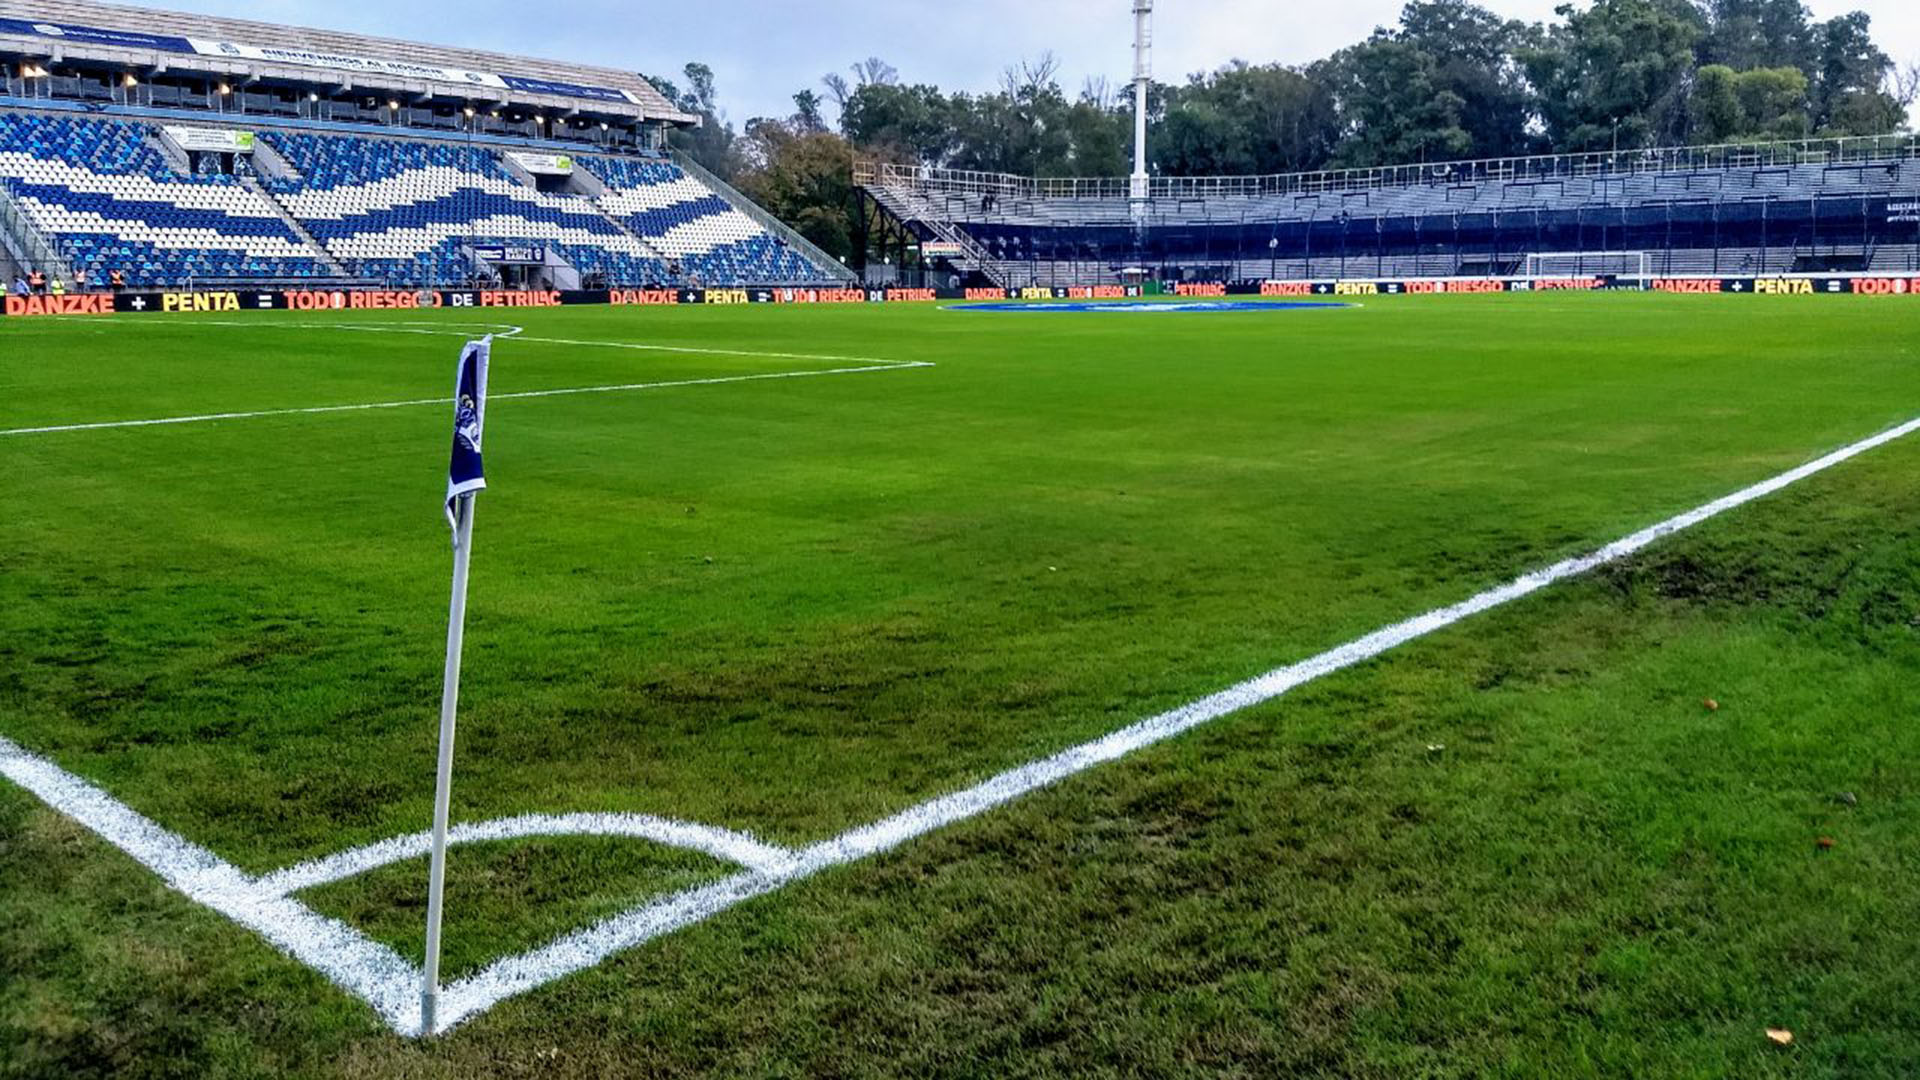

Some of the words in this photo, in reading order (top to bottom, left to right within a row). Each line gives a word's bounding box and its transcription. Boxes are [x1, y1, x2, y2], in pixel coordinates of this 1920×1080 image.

[260, 48, 362, 66] BIENVENIDOS
[964, 288, 1006, 300] DANZKE
[1021, 288, 1052, 300] PENTA
[1260, 282, 1312, 297] DANZKE
[1333, 282, 1377, 296] PENTA
[1402, 281, 1444, 294] TODO
[1446, 279, 1503, 294] RIESGO
[1510, 281, 1528, 292] DE
[1651, 279, 1721, 294] DANZKE
[1753, 279, 1814, 294] PENTA
[1849, 279, 1907, 294] TODO
[5, 293, 115, 315] DANZKE
[162, 292, 240, 312] PENTA
[283, 291, 346, 311] TODO
[350, 290, 442, 310] RIESGO
[452, 293, 473, 307] DE
[480, 290, 562, 307] PETRILAC
[609, 290, 678, 305] DANZKE
[704, 290, 748, 304] PENTA
[818, 288, 864, 303] RIESGO
[869, 290, 882, 302] DE
[886, 288, 935, 302] PETRILAC
